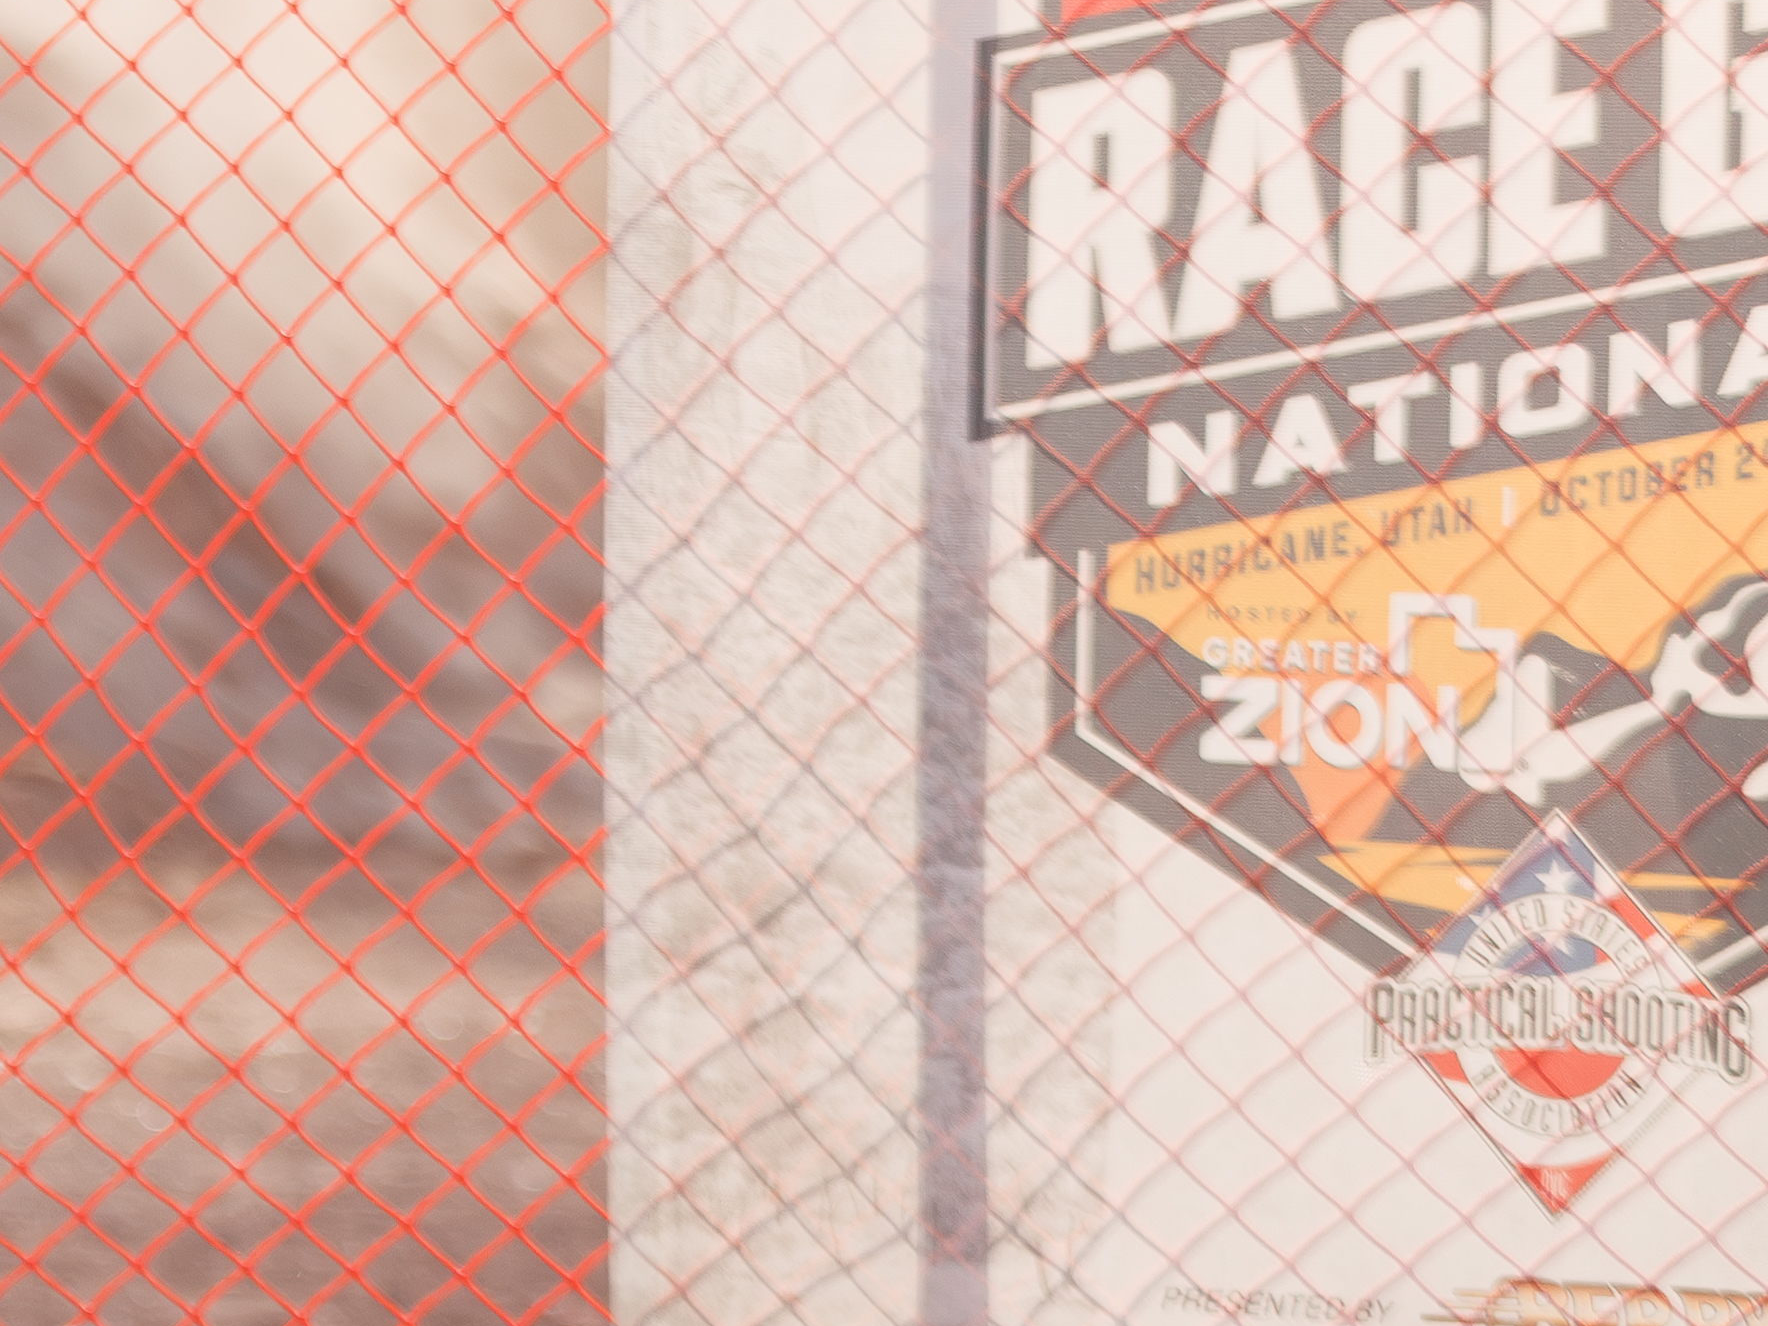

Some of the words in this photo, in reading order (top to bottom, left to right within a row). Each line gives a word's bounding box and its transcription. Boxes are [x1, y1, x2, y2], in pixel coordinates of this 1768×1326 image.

[1381, 496, 1476, 548] UTAH
[1539, 450, 1717, 517] OCTOBER
[1206, 603, 1310, 626] HOSTED
[1327, 607, 1359, 627] BY
[1201, 634, 1387, 675] GREATER
[1198, 672, 1458, 772] ZION
[1466, 906, 1549, 968] UNITED
[1563, 898, 1654, 975] STATES
[1369, 977, 1562, 1059] PRACTICAL
[1575, 980, 1752, 1079] SHOOTING
[1161, 1284, 1347, 1322] PRESENTED
[1355, 1297, 1395, 1323] BY
